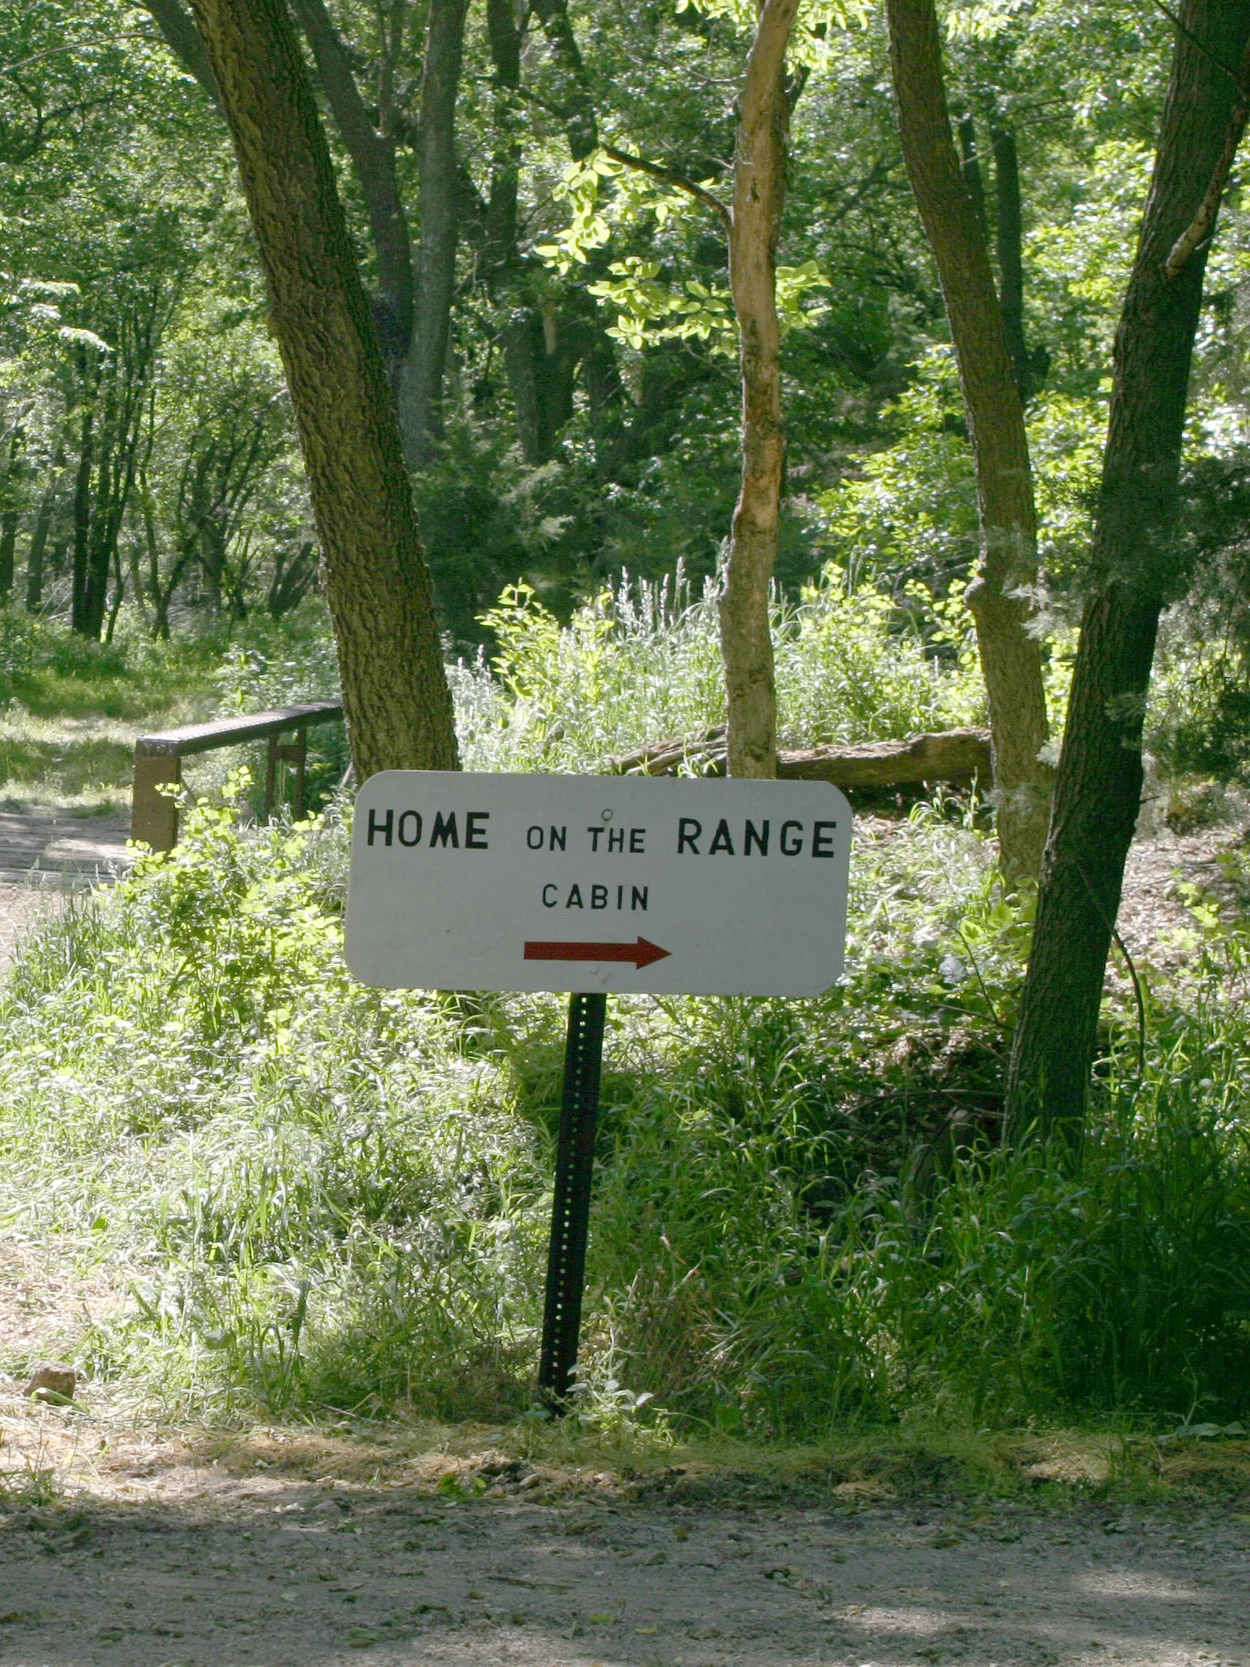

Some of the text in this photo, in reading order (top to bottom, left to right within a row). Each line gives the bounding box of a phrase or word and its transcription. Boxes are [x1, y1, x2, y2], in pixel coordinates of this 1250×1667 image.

[367, 808, 838, 859] HOME ON THE RANGE
[542, 883, 649, 912] CABIN
